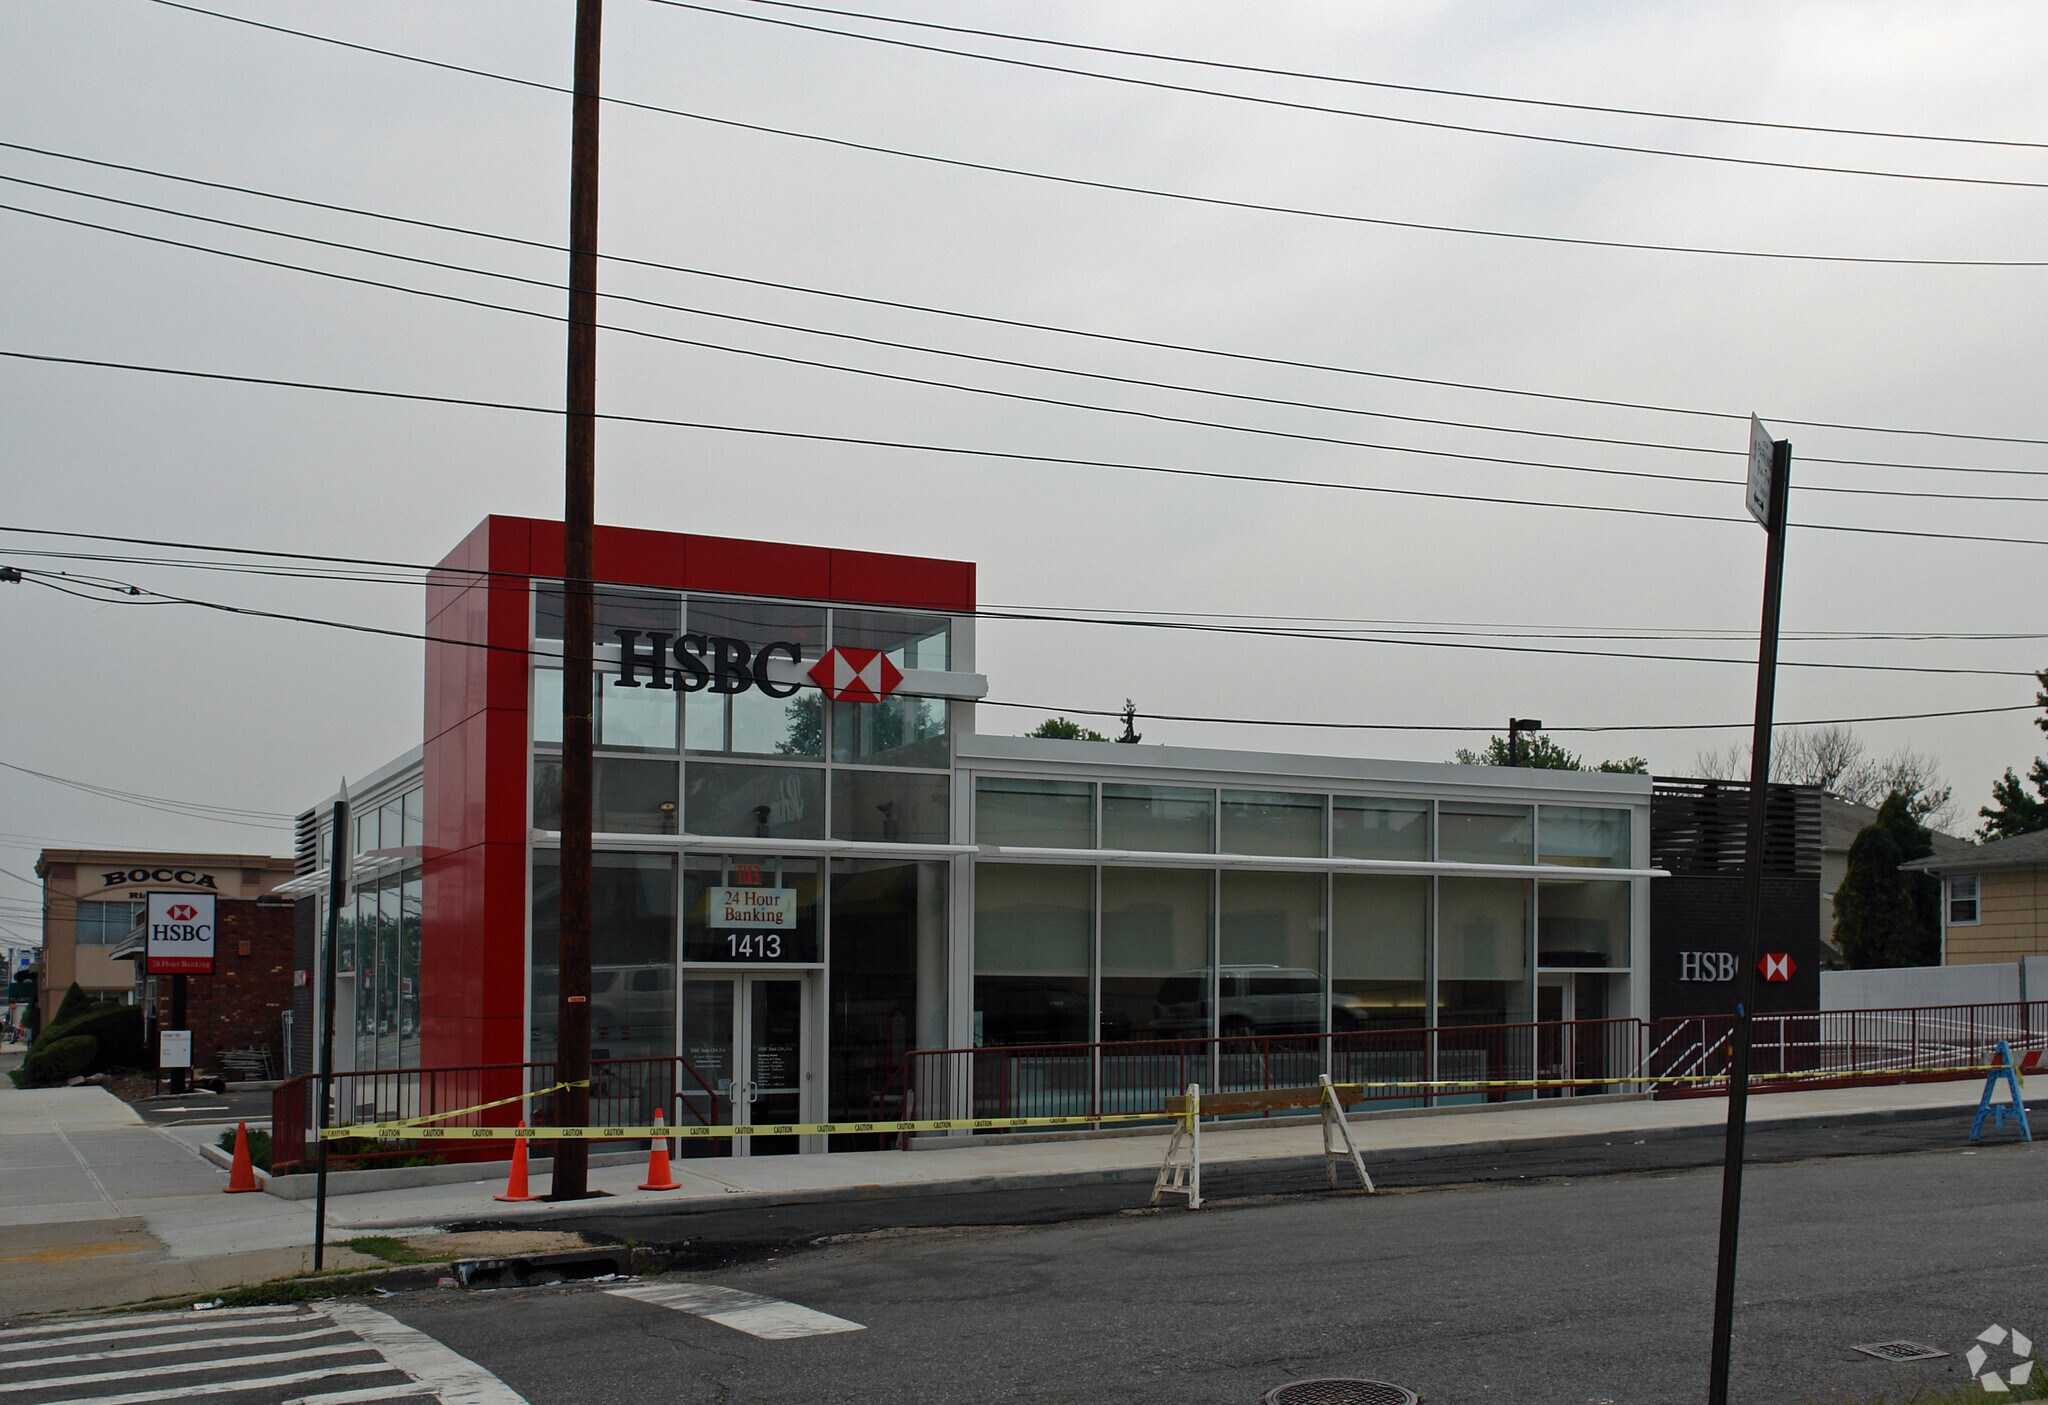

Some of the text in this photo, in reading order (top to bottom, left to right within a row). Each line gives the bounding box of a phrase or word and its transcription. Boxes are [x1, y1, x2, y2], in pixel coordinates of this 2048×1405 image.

[613, 629, 802, 698] HSBC
[101, 868, 218, 890] BOCCA
[724, 891, 781, 906] 24 Hour
[724, 907, 784, 924] Banking
[152, 924, 211, 942] HSBC
[727, 934, 781, 958] 1413
[162, 960, 179, 968] Hour
[181, 960, 210, 969] Banking
[1679, 951, 1740, 983] HSB
[327, 1129, 350, 1137] CAUTION
[378, 1129, 401, 1137] CAUTION
[422, 1129, 445, 1137] CAUTION
[472, 1129, 493, 1137] CAUTION
[515, 1129, 536, 1137] CAUTION
[562, 1129, 583, 1137] CAUTION
[604, 1128, 624, 1136] CAUTION
[650, 1128, 670, 1136] CAUTION
[690, 1127, 710, 1136] CAUTION
[735, 1126, 754, 1135] CAUTION
[773, 1126, 793, 1134] CAUTION
[816, 1124, 836, 1133] CAUTION
[854, 1124, 873, 1132] CAUTION
[896, 1122, 915, 1131] CAUTION
[933, 1121, 952, 1129] CAUTION
[974, 1120, 993, 1128] CAUTION
